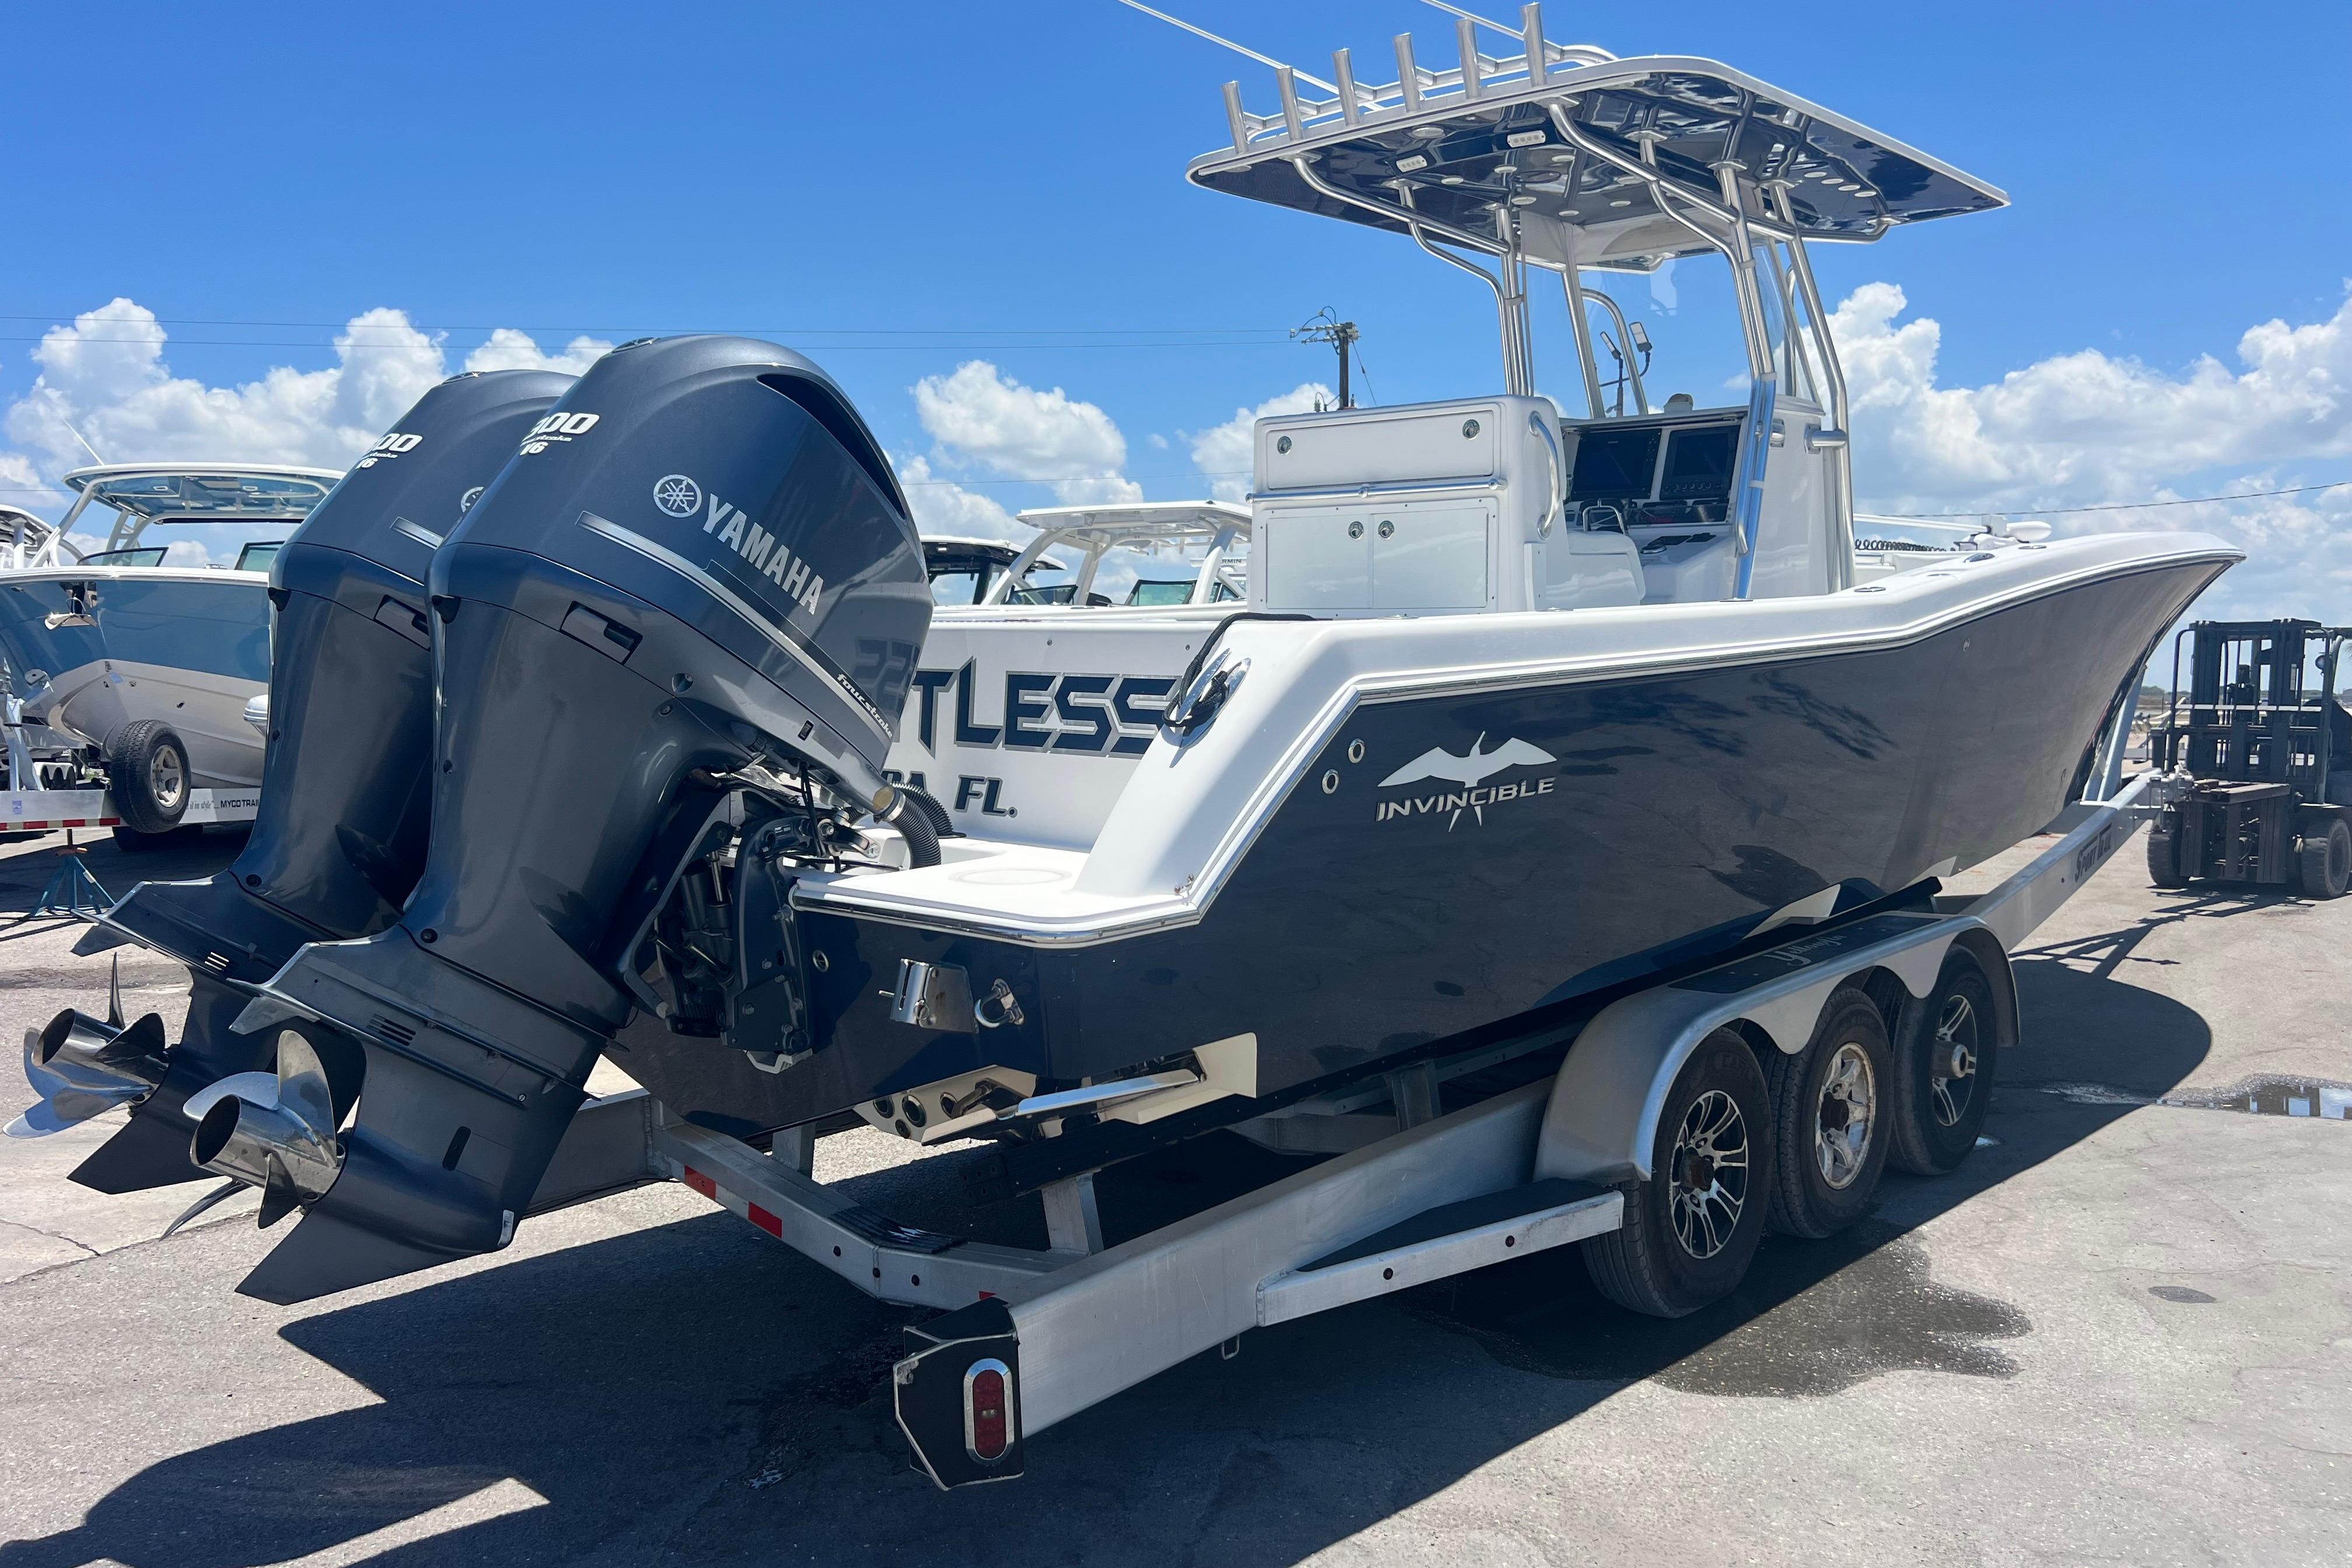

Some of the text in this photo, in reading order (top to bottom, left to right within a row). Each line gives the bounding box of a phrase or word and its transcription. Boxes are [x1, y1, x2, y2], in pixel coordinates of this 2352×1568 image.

[370, 433, 424, 453] 00
[702, 493, 824, 615] YAMAHA
[911, 655, 1184, 760] TLESS
[953, 774, 1018, 818] FL.
[1376, 777, 1556, 822] INVINCIBLE
